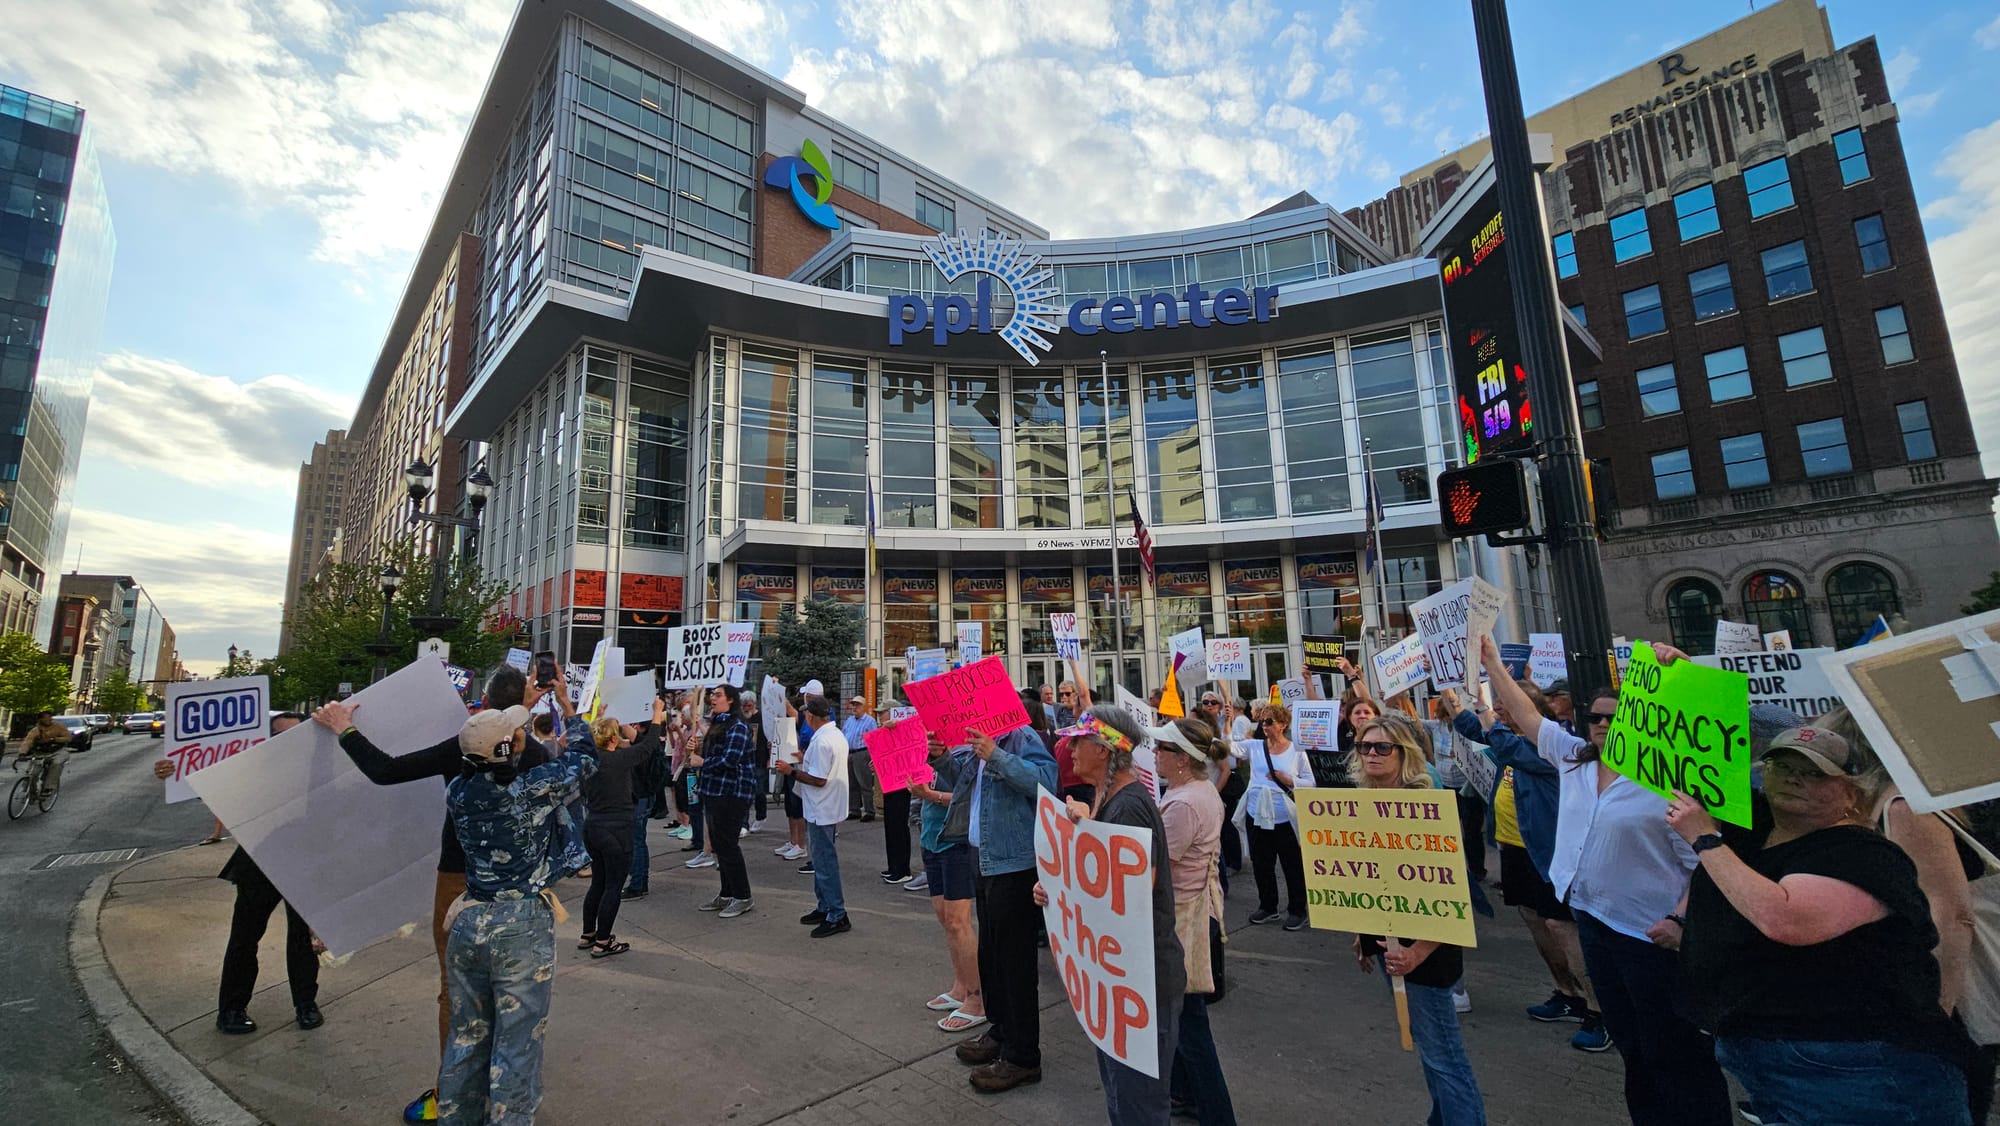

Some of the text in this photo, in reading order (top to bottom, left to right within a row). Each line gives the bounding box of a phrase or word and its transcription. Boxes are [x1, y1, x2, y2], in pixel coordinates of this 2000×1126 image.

[1658, 53, 1699, 86] R
[1609, 53, 1758, 127] RENAISSANCE
[1471, 211, 1503, 253] PLAYOFF
[888, 277, 1279, 346] ppl center
[1477, 358, 1507, 405] FRI
[1483, 399, 1511, 439] 5/9
[1038, 540, 1048, 548] 69
[1050, 540, 1074, 548] News
[1080, 538, 1125, 547] WFMZTV
[1244, 568, 1279, 580] NEWS
[1317, 563, 1355, 575] NEWS
[757, 576, 793, 588] NEWS
[830, 579, 865, 590] NEWS
[902, 579, 935, 590] NEWS
[970, 579, 1002, 590] NEWS
[1037, 577, 1071, 589] NEWS
[1105, 575, 1138, 587] NWS
[1173, 572, 1207, 584] NEWS
[1053, 614, 1075, 632] STOP
[1419, 607, 1442, 638] TRUMP
[683, 625, 721, 644] BOOKS
[684, 642, 711, 656] NOT
[1213, 641, 1240, 651] OMG
[1303, 641, 1344, 655] FAMILIES FIRST
[1545, 641, 1558, 649] NO
[1213, 652, 1240, 662] GOP
[1377, 645, 1406, 668] Respect
[1720, 653, 1802, 673] DEFEND
[446, 665, 466, 676] VOTE
[667, 654, 725, 681] FASCISTS
[1208, 663, 1244, 674] WTF?!!!
[1538, 661, 1566, 669] WITHOU
[450, 675, 469, 688] UE
[1533, 671, 1545, 679] DUE
[910, 680, 946, 708] DUE
[942, 659, 1004, 700] PROCESS
[571, 689, 579, 700] IS
[961, 694, 975, 706] not
[182, 694, 255, 734] GOOD
[893, 709, 905, 719] Due
[1300, 711, 1317, 719] HANDS
[1603, 728, 1626, 766] NO
[1637, 741, 1726, 812] KINGS
[1308, 800, 1441, 820] OUT WITH
[1307, 829, 1458, 853] OLIGARCHS
[1038, 795, 1148, 916] STOP
[1313, 859, 1456, 885] SAVE OUR
[1308, 888, 1469, 919] DEMOCRACY
[1057, 890, 1126, 978] the
